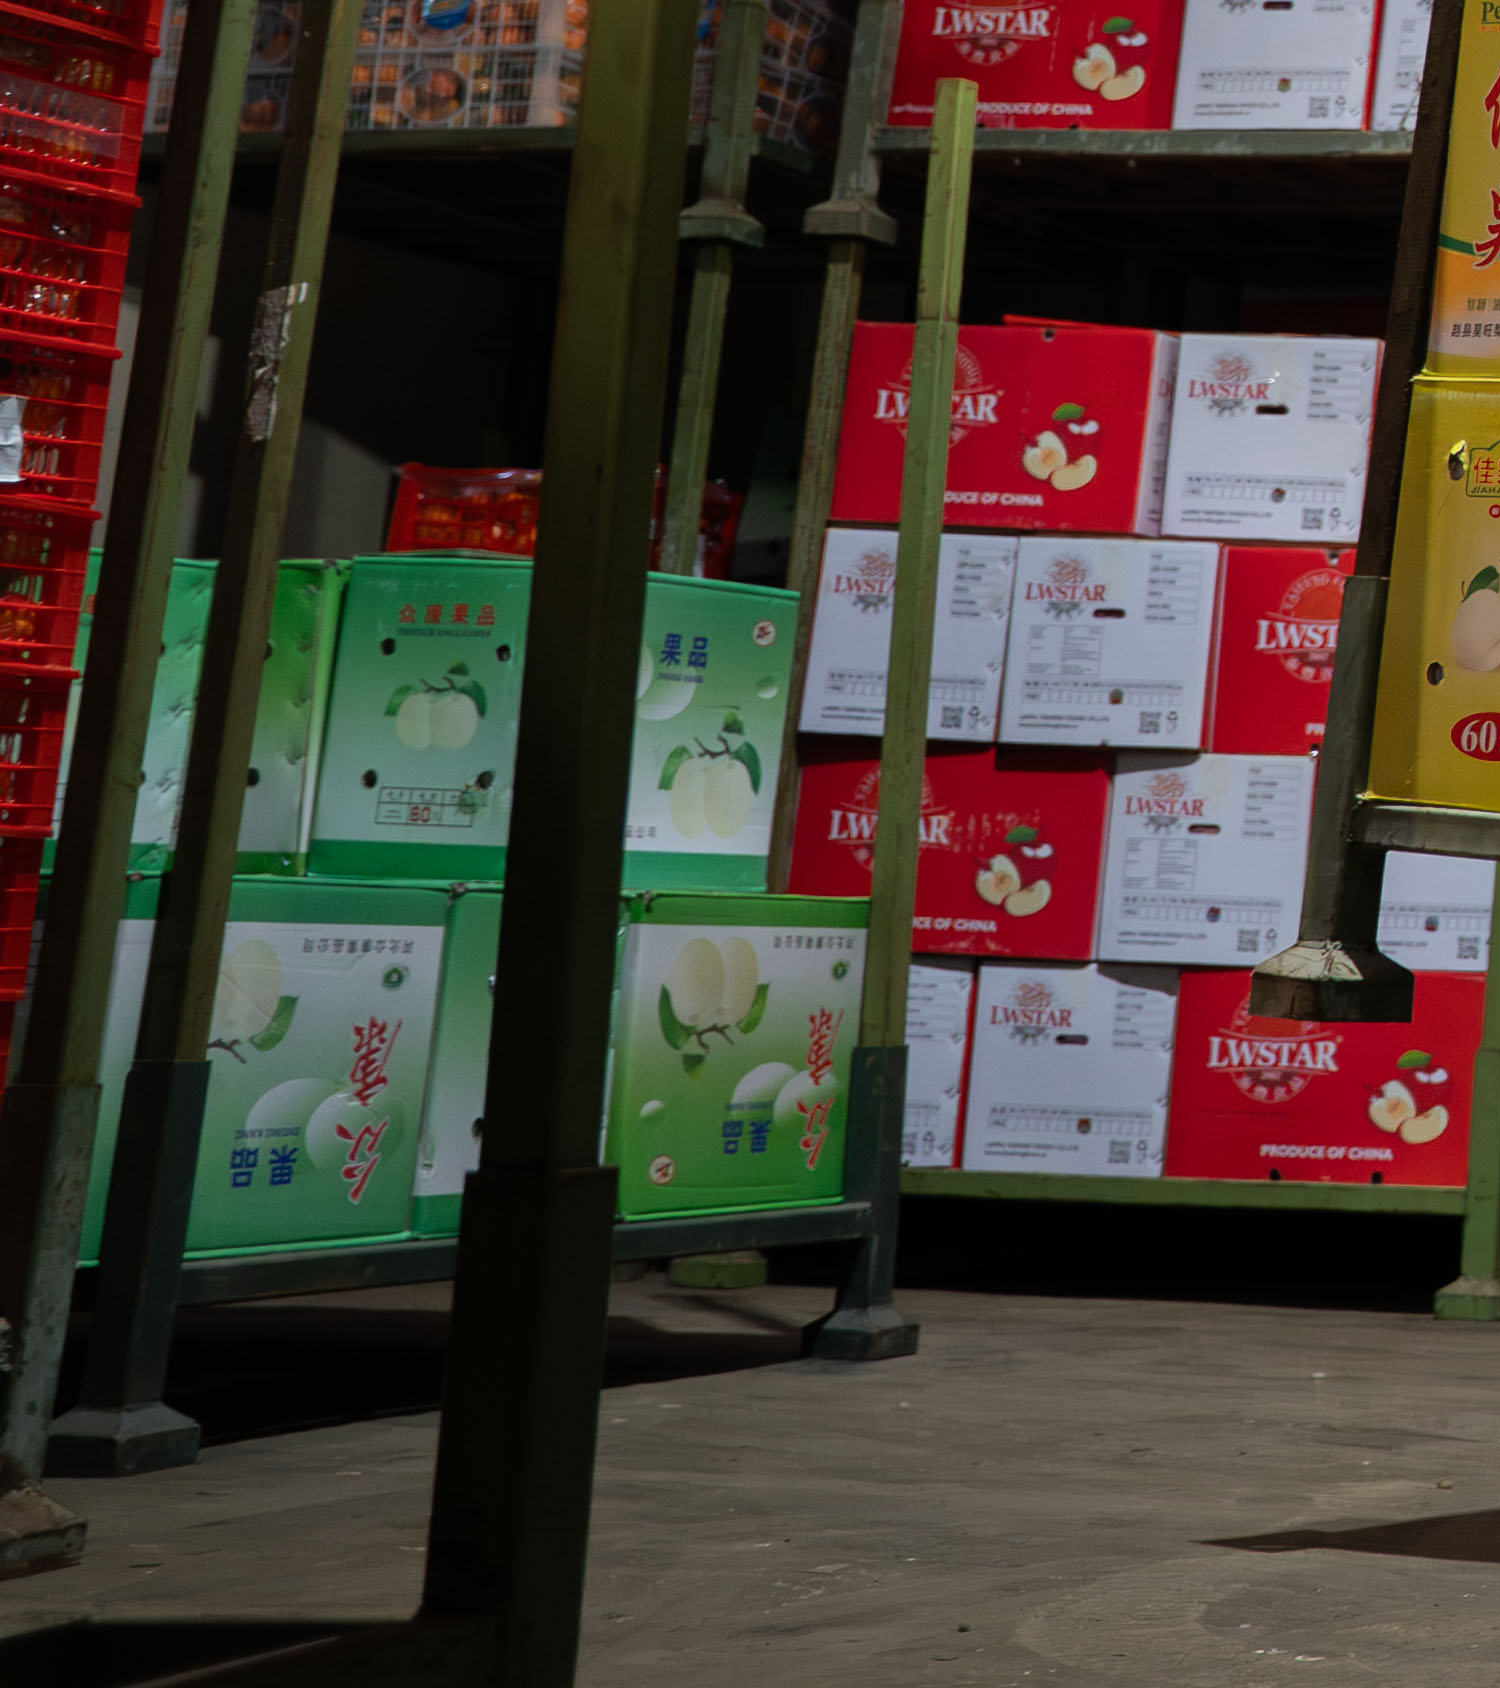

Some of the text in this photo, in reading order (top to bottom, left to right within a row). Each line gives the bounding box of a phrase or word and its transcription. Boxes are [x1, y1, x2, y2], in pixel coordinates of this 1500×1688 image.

[933, 7, 1050, 37] LWSTAR
[1188, 379, 1269, 401] LWSTAR
[1024, 582, 1106, 604] LWSTAR
[659, 633, 710, 670] 果品
[1460, 719, 1497, 754] 60
[1207, 1036, 1339, 1072] LWSTAR
[721, 1117, 772, 1157] 果品
[1259, 1144, 1394, 1162] PRODUCE OF CHINA
[229, 1143, 298, 1189] 果品
